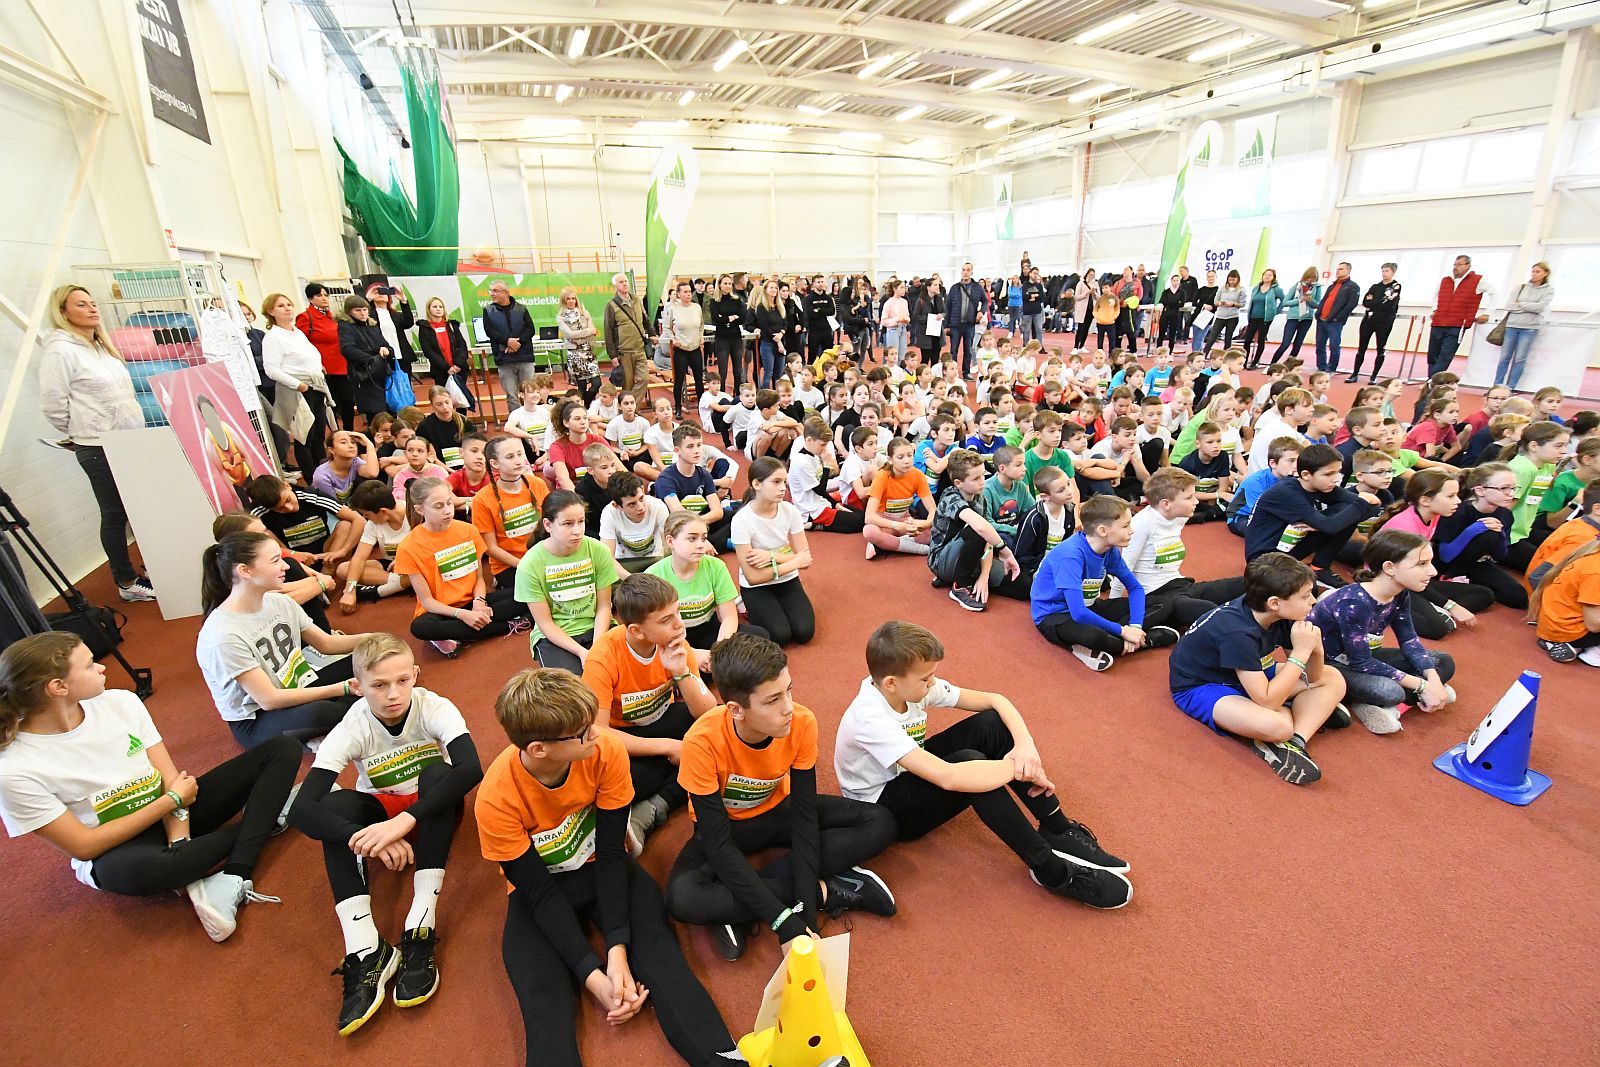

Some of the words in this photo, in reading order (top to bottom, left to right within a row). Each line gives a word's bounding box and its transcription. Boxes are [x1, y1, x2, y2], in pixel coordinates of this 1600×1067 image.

[1205, 261, 1231, 271] STAR
[256, 623, 295, 674] 38
[367, 744, 419, 768] ARAKAKTIV
[404, 763, 422, 777] MÁTÉ
[95, 774, 153, 802] ARAKAKTIV
